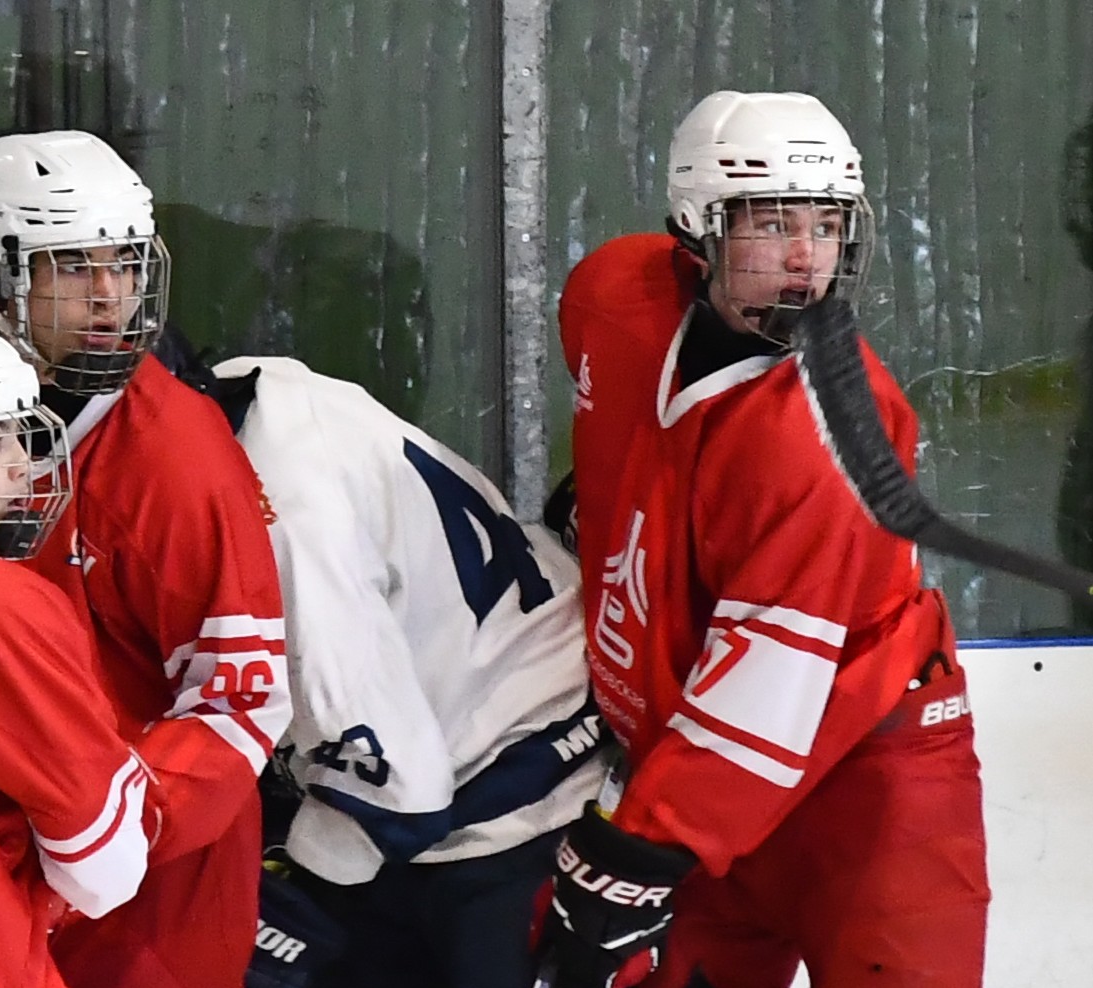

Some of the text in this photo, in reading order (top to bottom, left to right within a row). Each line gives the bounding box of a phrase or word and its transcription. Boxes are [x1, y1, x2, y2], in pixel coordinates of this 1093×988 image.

[787, 154, 835, 164] CCM
[556, 838, 673, 908] AUER
[255, 919, 307, 963] OR
